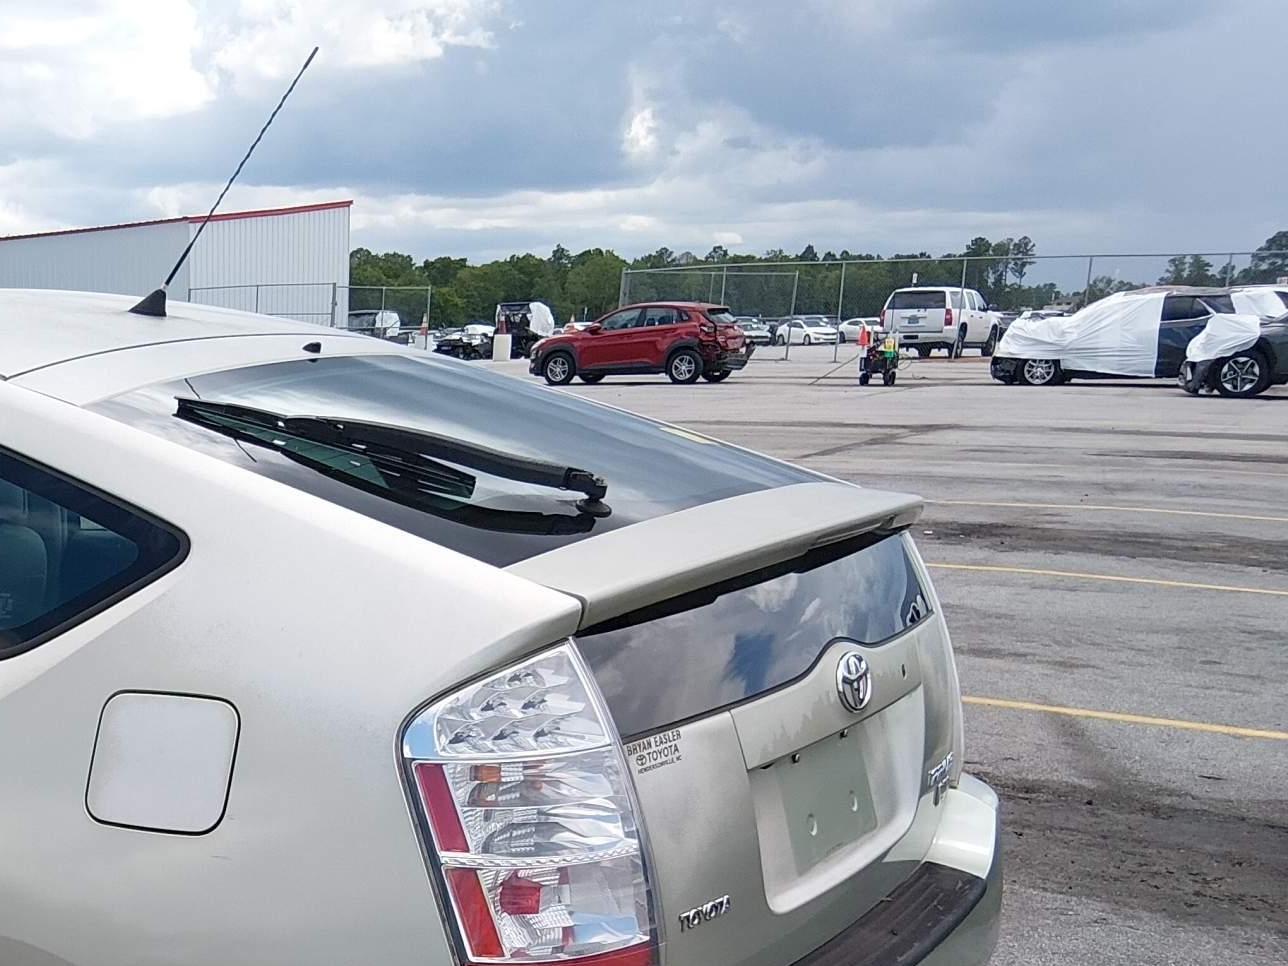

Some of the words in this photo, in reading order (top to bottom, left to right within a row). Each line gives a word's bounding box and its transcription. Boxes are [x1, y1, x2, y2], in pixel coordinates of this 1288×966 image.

[626, 740, 653, 757] BRYAN
[654, 729, 682, 746] EASLER
[646, 743, 680, 763] TOYOTA
[678, 894, 731, 933] TOYOTA
